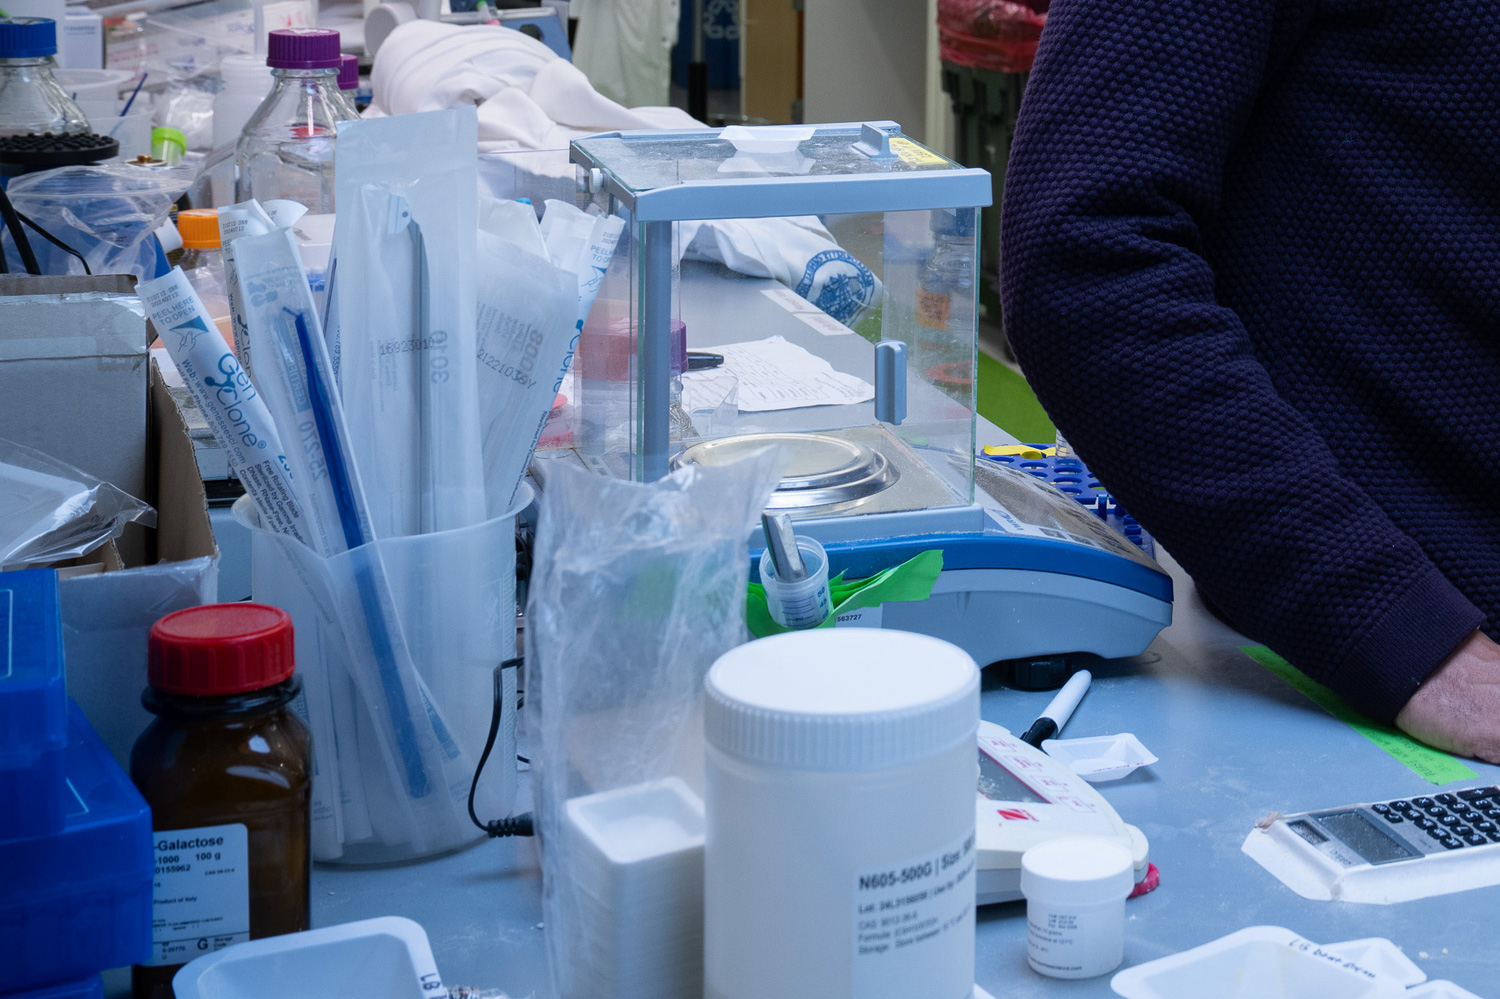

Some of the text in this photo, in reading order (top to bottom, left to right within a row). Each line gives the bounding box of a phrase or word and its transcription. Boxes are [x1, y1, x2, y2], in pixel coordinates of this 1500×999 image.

[146, 284, 179, 303] 210712-288
[150, 292, 179, 308] 20240712
[151, 296, 195, 321] PEEL HERE
[160, 305, 196, 326] TO OPEN
[218, 352, 257, 401] Gen
[182, 358, 247, 465] Web: www.geneseesci.com
[238, 468, 259, 500] Contents
[255, 494, 270, 518] sterile
[266, 513, 273, 523] if
[246, 466, 261, 490] DNase,
[260, 487, 284, 530] RNase-Free,
[254, 463, 274, 495] Sterilized
[270, 492, 279, 504] by
[275, 499, 292, 526] Gamma
[262, 460, 275, 476] Free
[272, 473, 289, 503] Rotating
[286, 500, 299, 519] Blade
[153, 837, 224, 852] -Galactose
[196, 852, 212, 861] 100
[214, 853, 221, 861] g
[859, 860, 932, 891] N605-500G
[153, 897, 177, 905] Product
[197, 938, 209, 951] G
